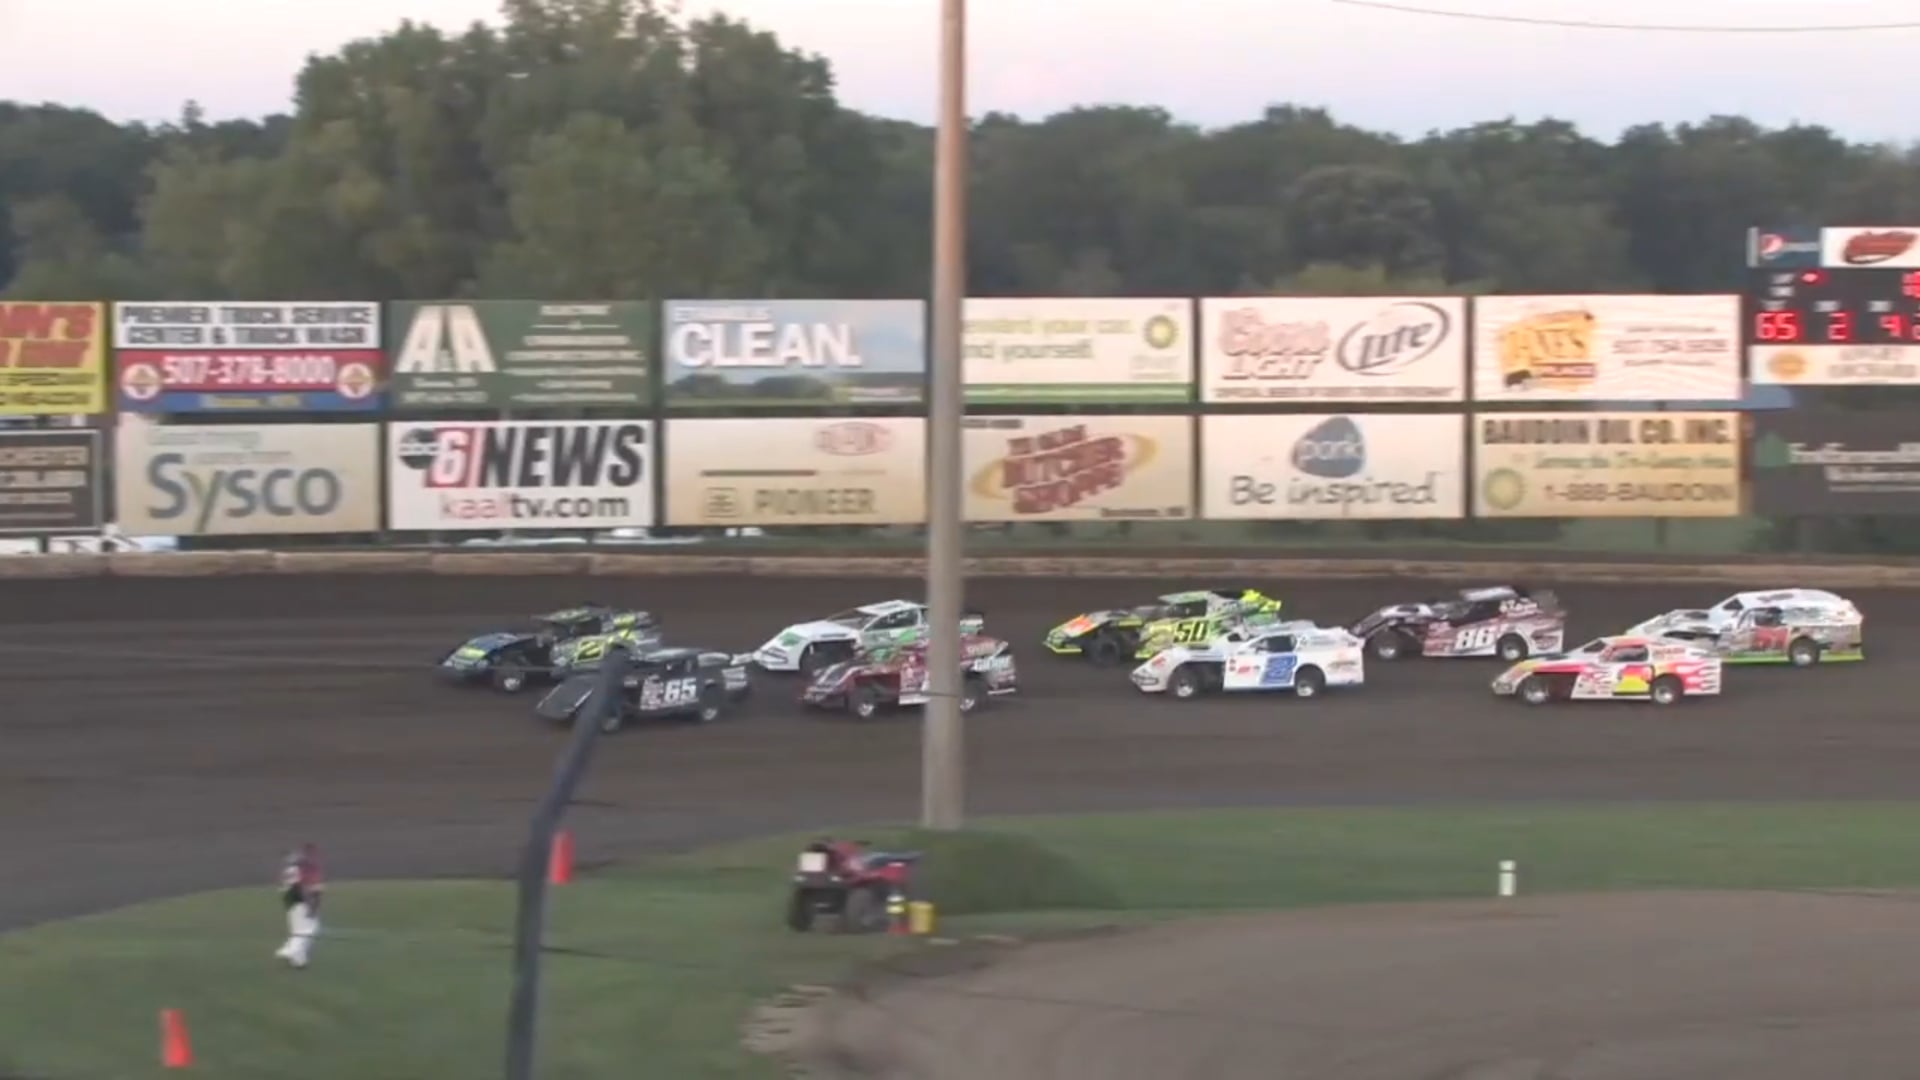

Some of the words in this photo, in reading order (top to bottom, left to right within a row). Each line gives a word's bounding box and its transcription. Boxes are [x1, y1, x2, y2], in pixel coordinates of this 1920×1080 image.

[219, 306, 281, 324] TRUCK
[292, 306, 373, 324] SERVICE
[1756, 312, 1797, 340] 65
[1829, 312, 1847, 340] 2
[127, 326, 203, 344] CENTER
[233, 326, 297, 344] TRUCK
[306, 326, 366, 344] WASH
[1484, 419, 1590, 444] BAUDOIN
[1640, 419, 1680, 444] CO.
[477, 424, 646, 488] NEWS
[146, 452, 342, 533] Sysco
[754, 488, 876, 515] PIONEER
[1231, 474, 1277, 505] Be
[1286, 471, 1438, 517] inspired
[1173, 620, 1209, 643] 50
[664, 678, 698, 703] 65
